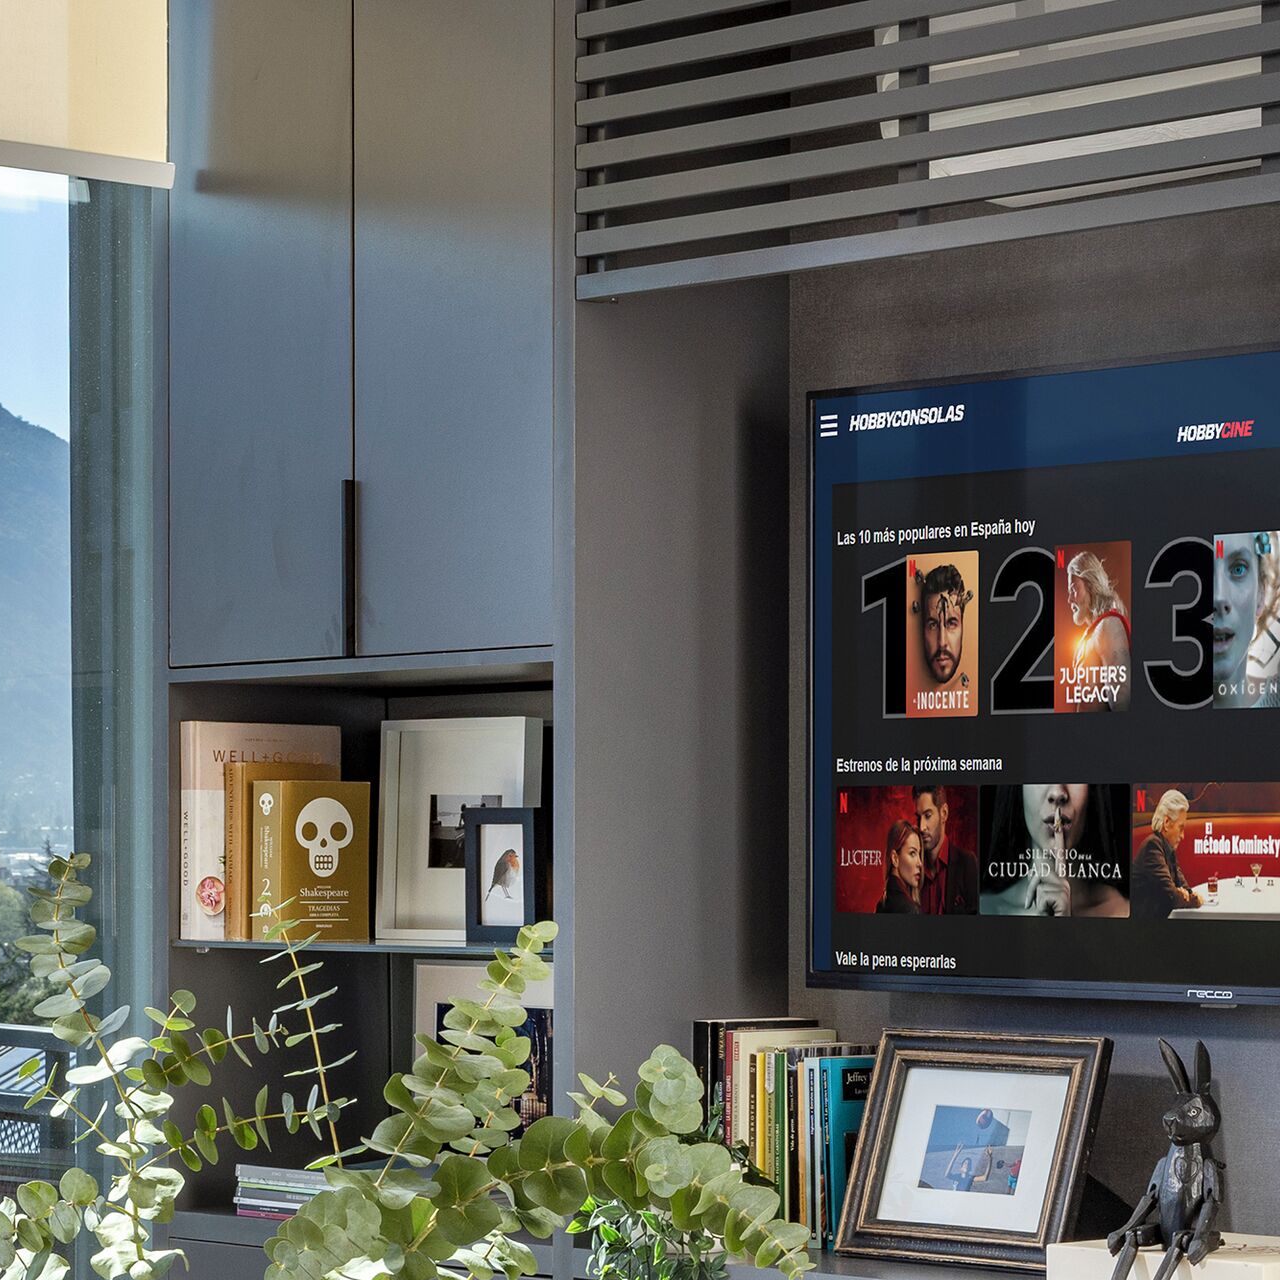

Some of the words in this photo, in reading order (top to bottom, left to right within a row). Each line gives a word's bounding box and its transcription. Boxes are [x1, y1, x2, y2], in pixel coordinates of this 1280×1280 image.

[849, 404, 965, 431] HOBBYCONSOLAS
[1177, 420, 1254, 442] HOBBYCINE
[837, 531, 856, 546] Las
[858, 530, 871, 544] 10
[873, 527, 895, 543] más
[898, 523, 952, 545] populares
[954, 524, 968, 538] en
[970, 518, 1012, 539] España
[1015, 518, 1036, 536] hoy
[990, 546, 1055, 715] 2
[1144, 536, 1214, 710] 3
[1060, 666, 1127, 685] JUPITER'S
[917, 691, 969, 710] INOCENTE
[1065, 685, 1120, 704] LEGACY
[836, 758, 883, 773] Estrenos
[885, 757, 898, 772] de
[901, 757, 911, 772] la
[913, 755, 957, 775] próxima
[960, 757, 1003, 771] semana
[1025, 848, 1078, 860] SILENCIO
[1194, 834, 1231, 855] método
[1231, 835, 1280, 858] Kominsky
[988, 862, 1051, 878] CIUDAD
[1058, 862, 1122, 878] BLANCA
[262, 878, 272, 896] 2
[300, 888, 349, 899] Shakespeare
[835, 951, 857, 966] Vale
[860, 952, 869, 966] la
[872, 953, 898, 970] pena
[900, 953, 956, 971] esperarlas
[846, 1072, 867, 1085] Jeffrey
